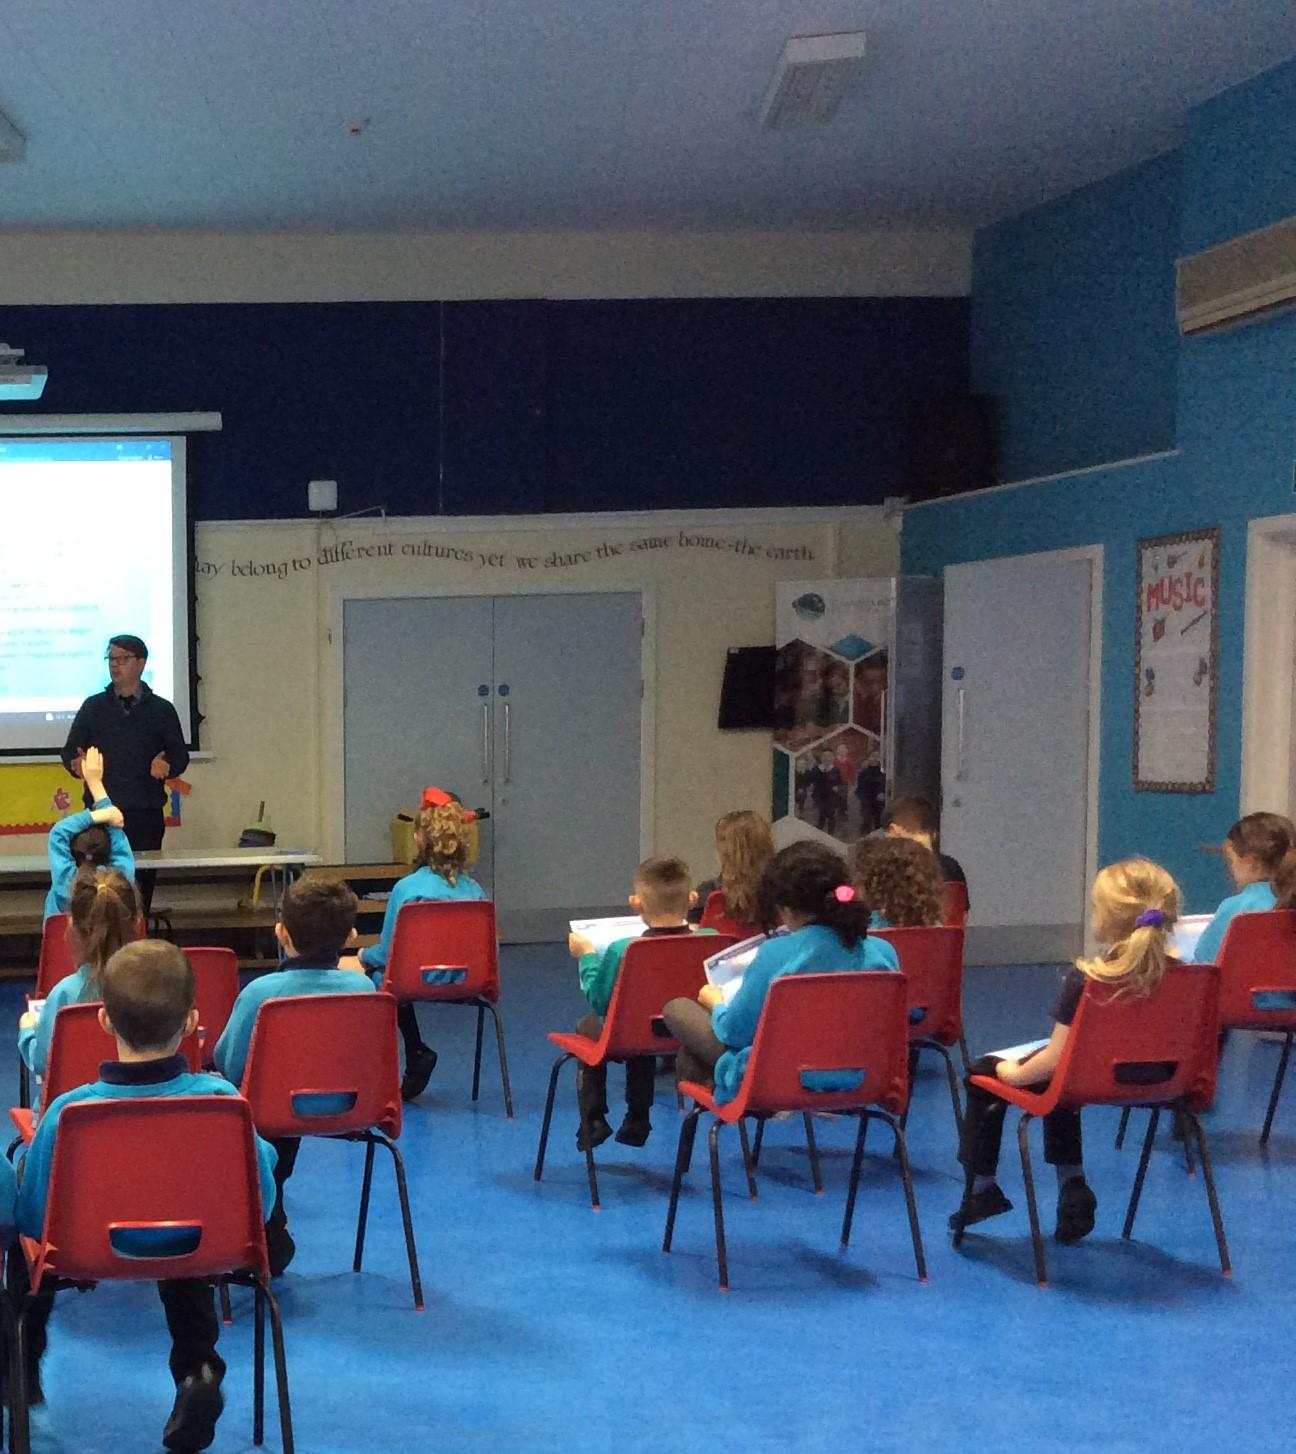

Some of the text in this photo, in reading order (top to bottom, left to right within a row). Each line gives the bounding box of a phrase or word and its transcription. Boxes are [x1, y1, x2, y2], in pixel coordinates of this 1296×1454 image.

[232, 559, 288, 579] belong
[292, 556, 312, 572] to
[317, 540, 394, 565] different
[401, 540, 474, 562] cultures
[516, 556, 538, 569] we
[544, 551, 592, 568] share
[596, 542, 624, 558] the
[630, 535, 673, 551] same
[766, 544, 816, 561] earth
[1147, 572, 1206, 612] MUSIC
